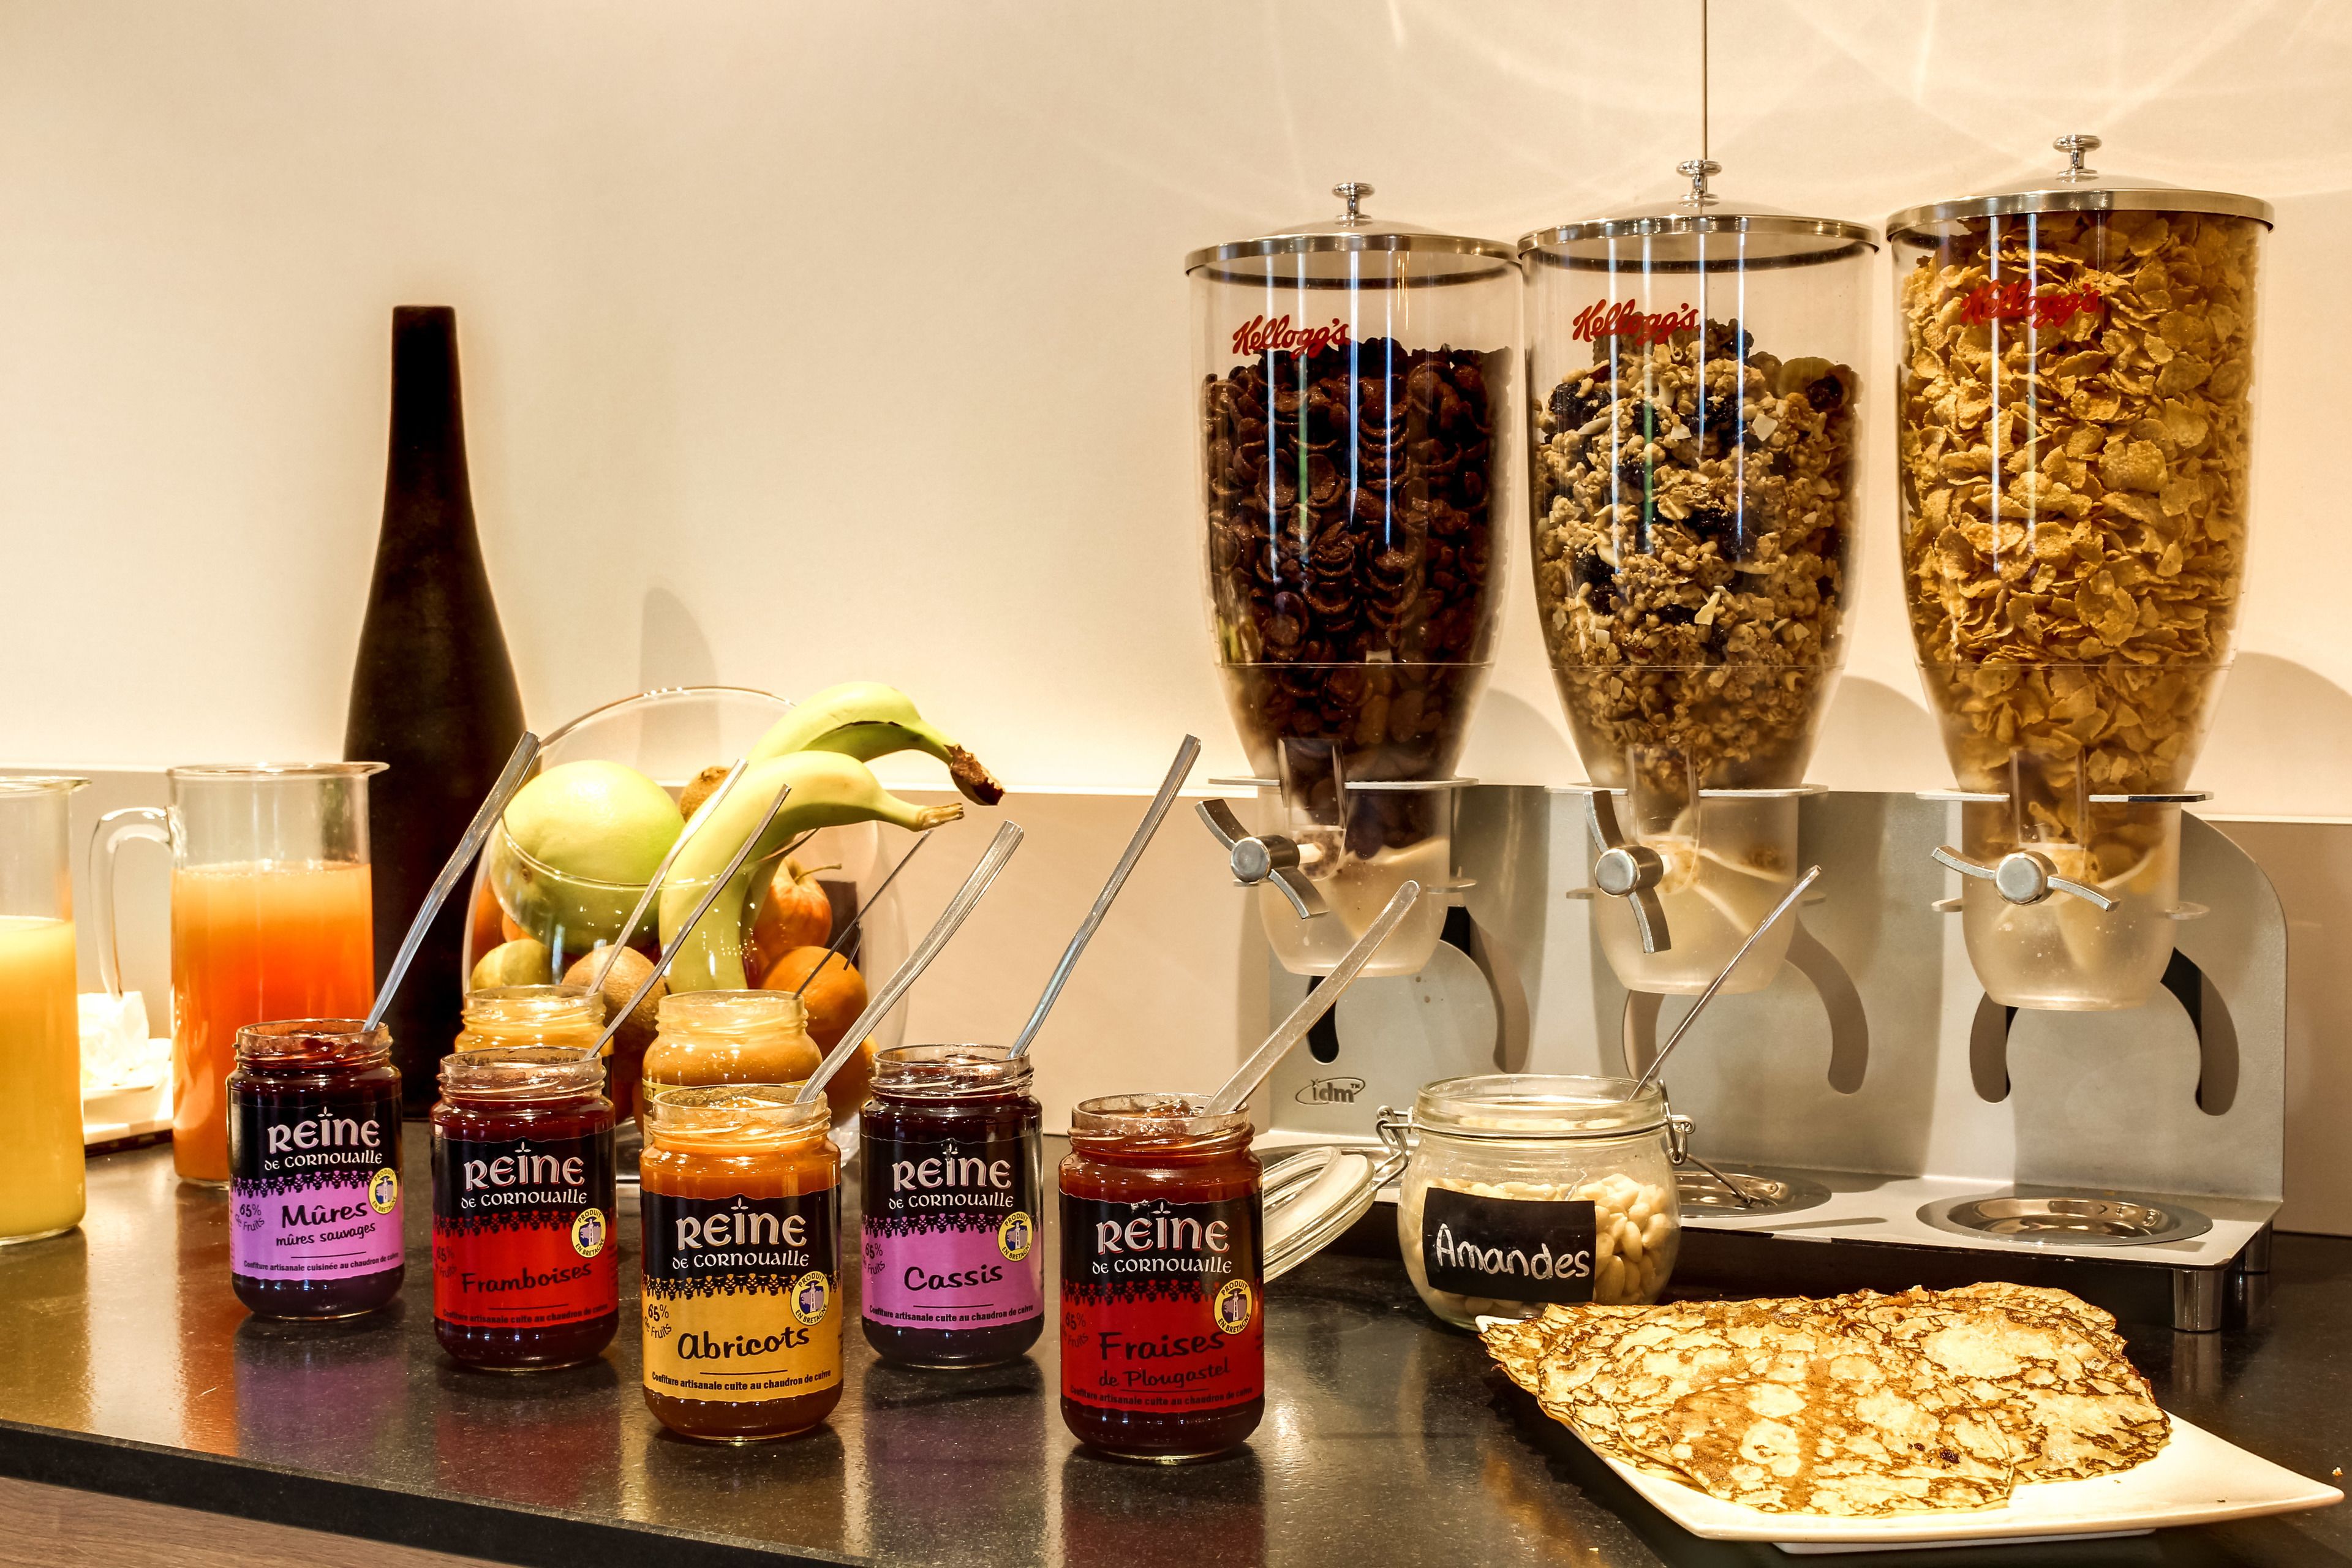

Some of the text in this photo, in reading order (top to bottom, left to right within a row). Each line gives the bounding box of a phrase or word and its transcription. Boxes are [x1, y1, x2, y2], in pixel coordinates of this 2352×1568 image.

[1961, 279, 2101, 330] Kellogg's
[1572, 299, 1699, 347] Kellogg's
[1232, 314, 1349, 360] Kellogg's
[1311, 1079, 1354, 1102] idm
[374, 1169, 394, 1182] PRODUIT
[239, 1203, 262, 1218] 65%
[282, 1202, 368, 1228] Mûres
[578, 1210, 601, 1223] PRODUIT
[1005, 1213, 1028, 1226] PRODUIT
[243, 1218, 265, 1231] Fruits
[276, 1223, 375, 1246] mûres sauvages
[575, 1238, 604, 1256] EN BRETAGNE
[865, 1243, 883, 1259] 65%
[1001, 1246, 1009, 1255] EN
[1436, 1223, 1590, 1280] Amandes
[244, 1260, 268, 1270] Confiture
[307, 1262, 338, 1271] cuisinée
[350, 1257, 380, 1267] chaudron
[867, 1261, 885, 1275] Fruits
[461, 1263, 592, 1293] Framboises
[798, 1273, 824, 1287] PRODUIT
[904, 1264, 1003, 1291] Cassis
[1221, 1281, 1248, 1295] PRODUIT
[648, 1303, 669, 1322] 65%
[795, 1303, 827, 1324] EN BRETAGNE
[869, 1305, 894, 1318] Confiture
[895, 1312, 933, 1322] artisanale
[935, 1313, 957, 1322] cuite
[971, 1311, 1008, 1321] chaudron
[1008, 1308, 1016, 1316] de
[1066, 1311, 1086, 1330] 65%
[644, 1316, 672, 1338] de Fruits
[1218, 1313, 1250, 1333] EN BRETAGNE
[677, 1326, 810, 1359] Abricots
[1098, 1330, 1225, 1360] Fraises
[652, 1371, 679, 1386] Confiture
[680, 1379, 722, 1390] artisanale
[724, 1381, 748, 1390] cuite
[763, 1378, 803, 1389] chaudron
[804, 1374, 813, 1383] de
[814, 1370, 831, 1381] cuivre
[1099, 1357, 1231, 1388] de Plougastel
[1099, 1393, 1142, 1405] artisanale
[1145, 1397, 1168, 1406] cuite
[1185, 1393, 1224, 1404] chaudron
